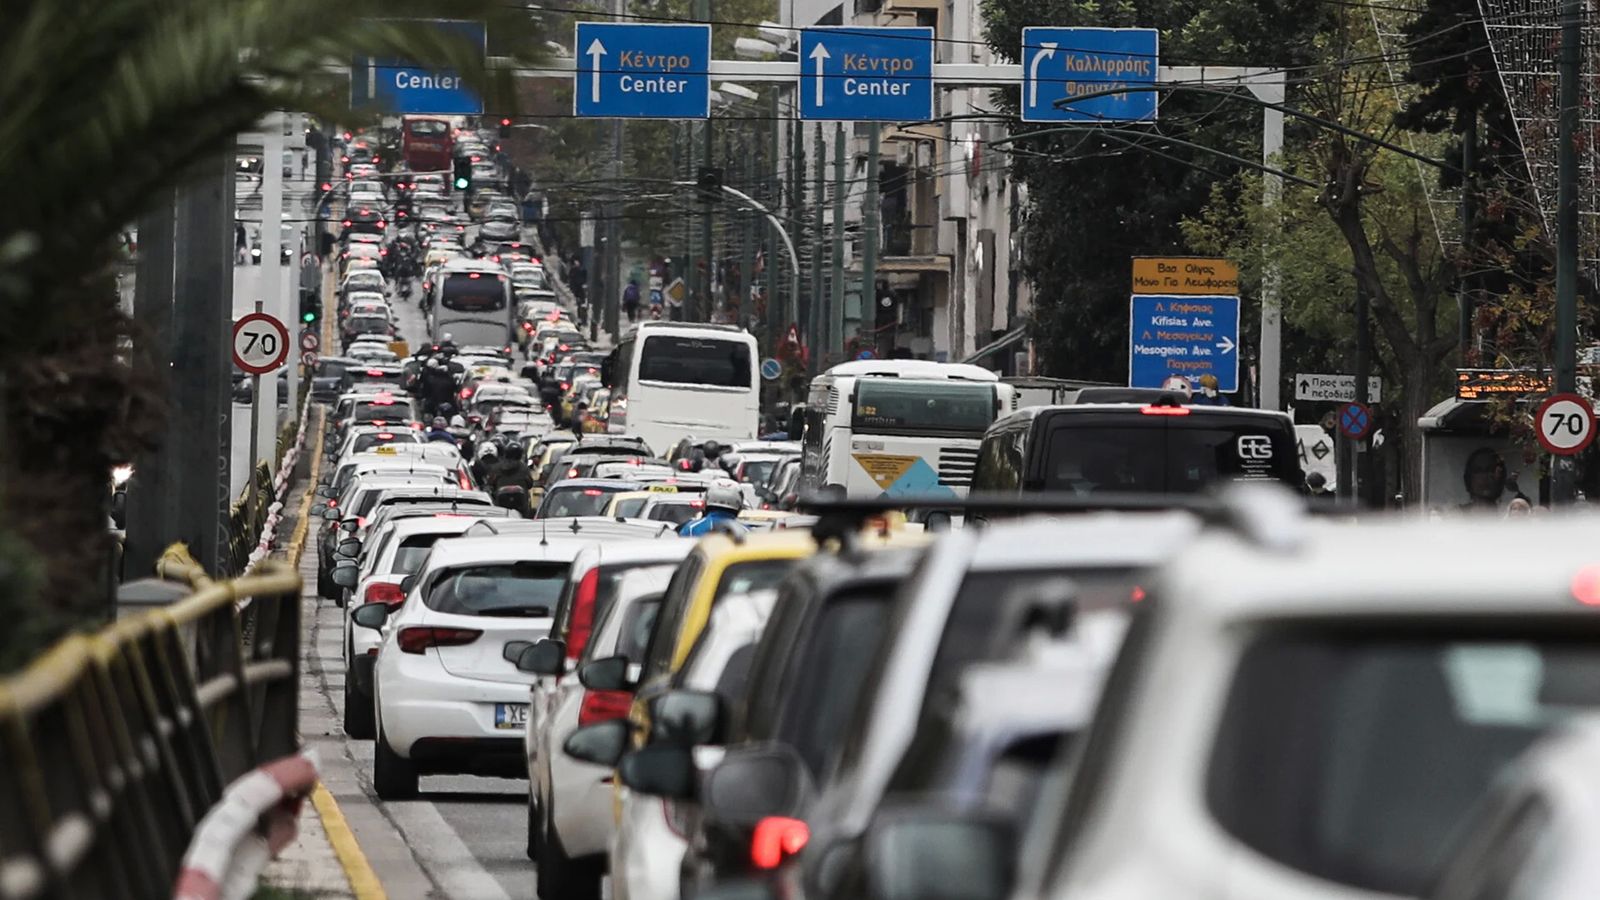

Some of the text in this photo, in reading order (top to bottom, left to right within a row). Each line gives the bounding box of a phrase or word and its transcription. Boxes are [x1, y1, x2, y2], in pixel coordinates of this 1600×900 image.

[620, 51, 691, 73] Κέντρο
[844, 54, 914, 75] Κέντρο
[1066, 54, 1151, 76] Καλλιρρόης
[396, 71, 462, 90] Center
[620, 75, 688, 93] Center
[844, 78, 911, 96] Center
[1152, 316, 1214, 327] Kifisias Ave.
[243, 332, 276, 355] 70
[1134, 344, 1188, 357] Mesogeion
[1312, 377, 1337, 388] Προς
[1549, 413, 1583, 436] 70
